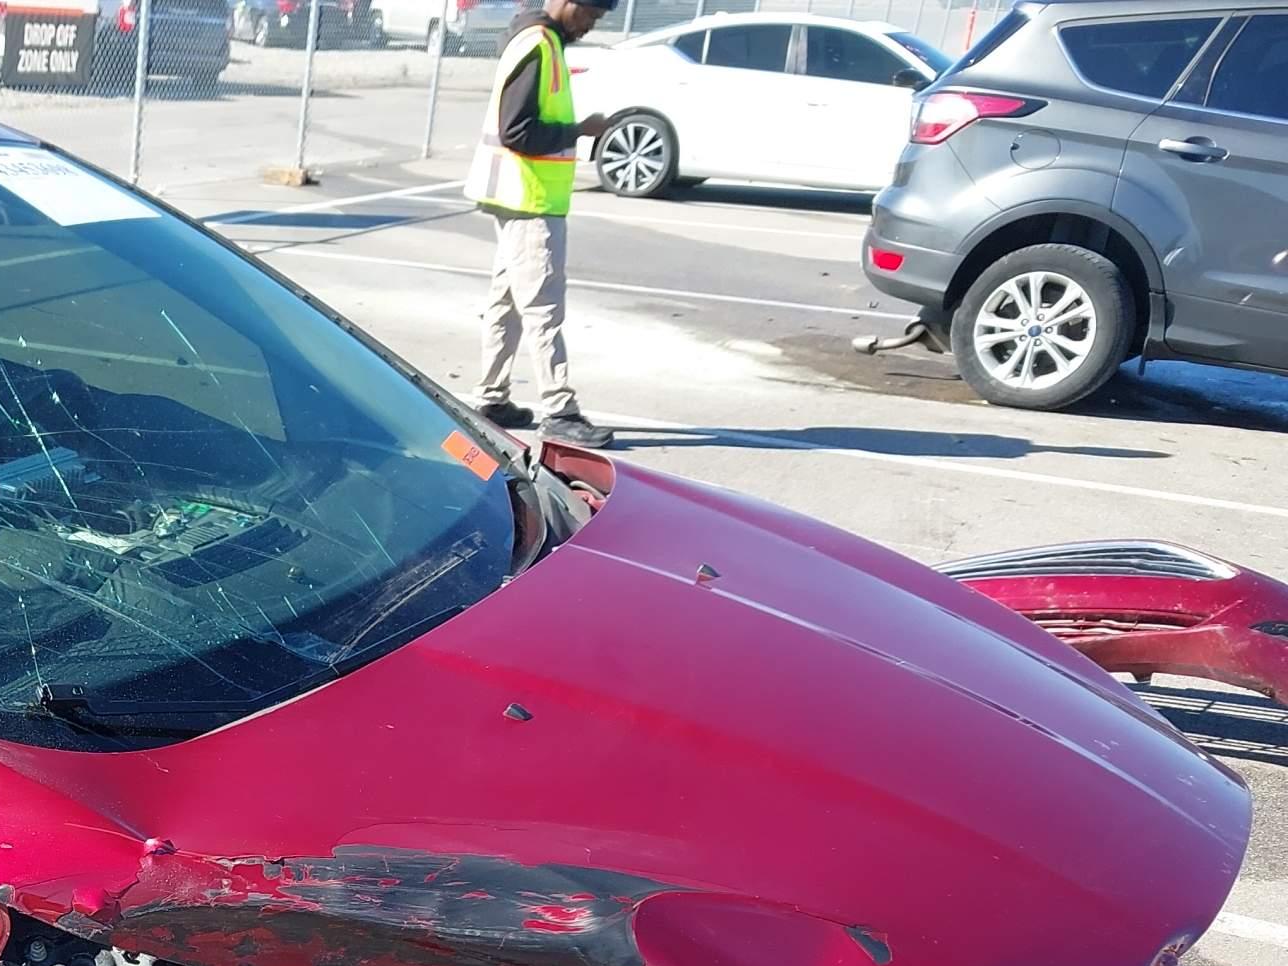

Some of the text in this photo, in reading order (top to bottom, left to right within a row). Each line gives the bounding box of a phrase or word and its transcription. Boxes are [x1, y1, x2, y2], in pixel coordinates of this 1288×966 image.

[24, 23, 77, 47] DROP OFF
[17, 49, 80, 73] ZONE ONLY
